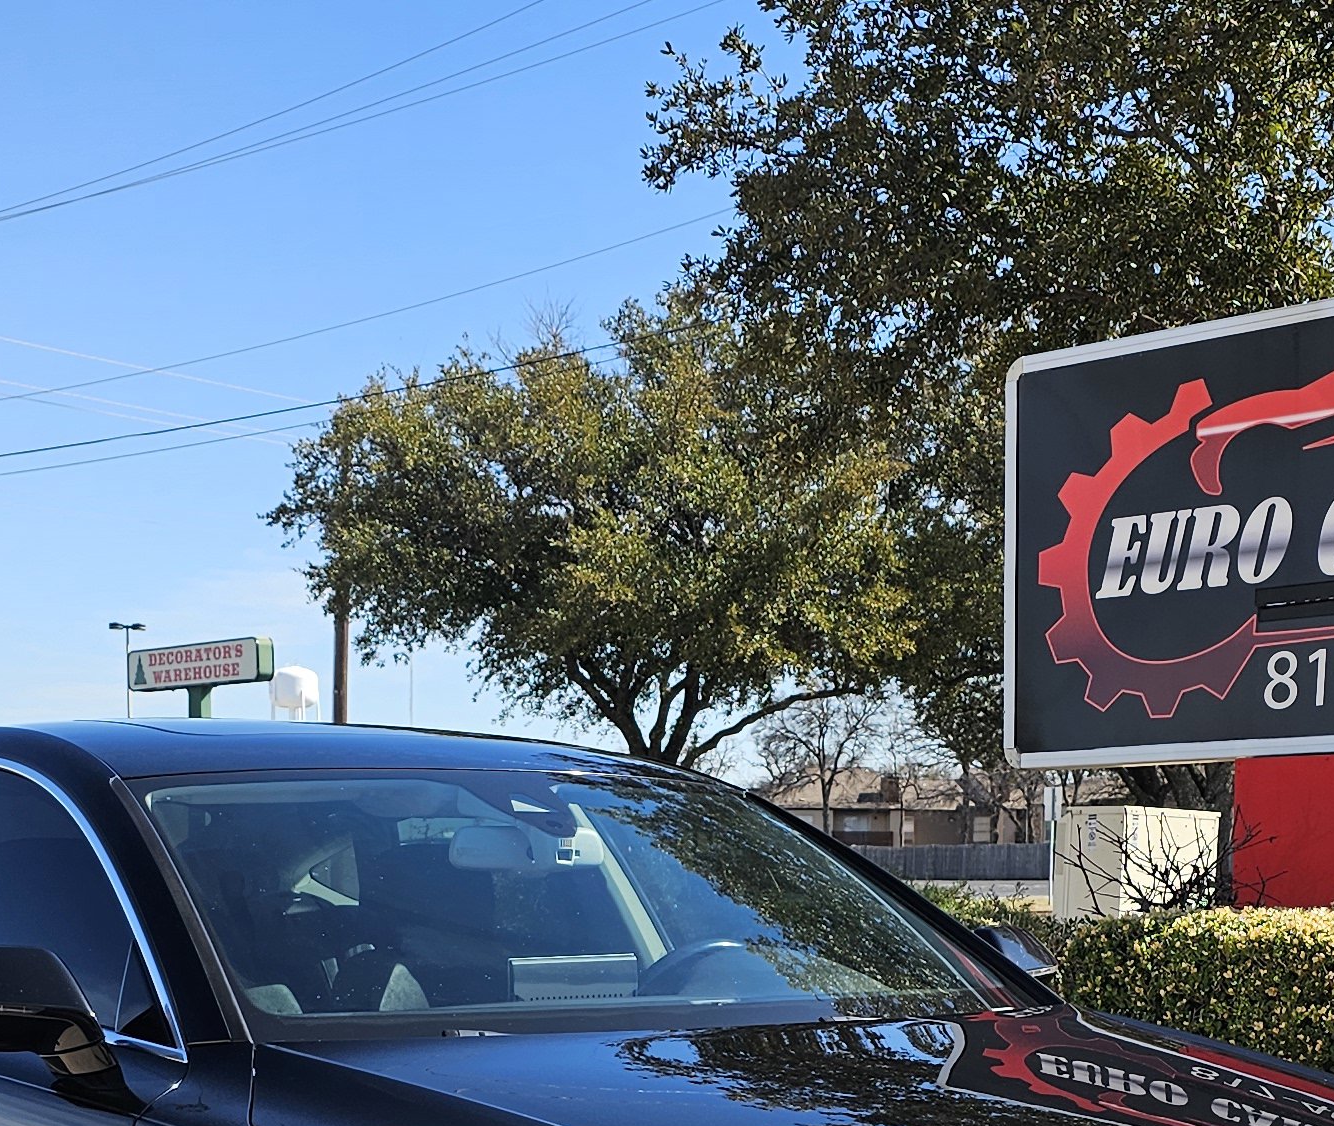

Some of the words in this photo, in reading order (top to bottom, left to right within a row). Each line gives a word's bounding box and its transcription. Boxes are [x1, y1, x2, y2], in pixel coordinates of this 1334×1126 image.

[1094, 496, 1294, 600] EURO
[148, 643, 244, 667] DECORATOR'S
[152, 662, 240, 684] WAREHOUSE
